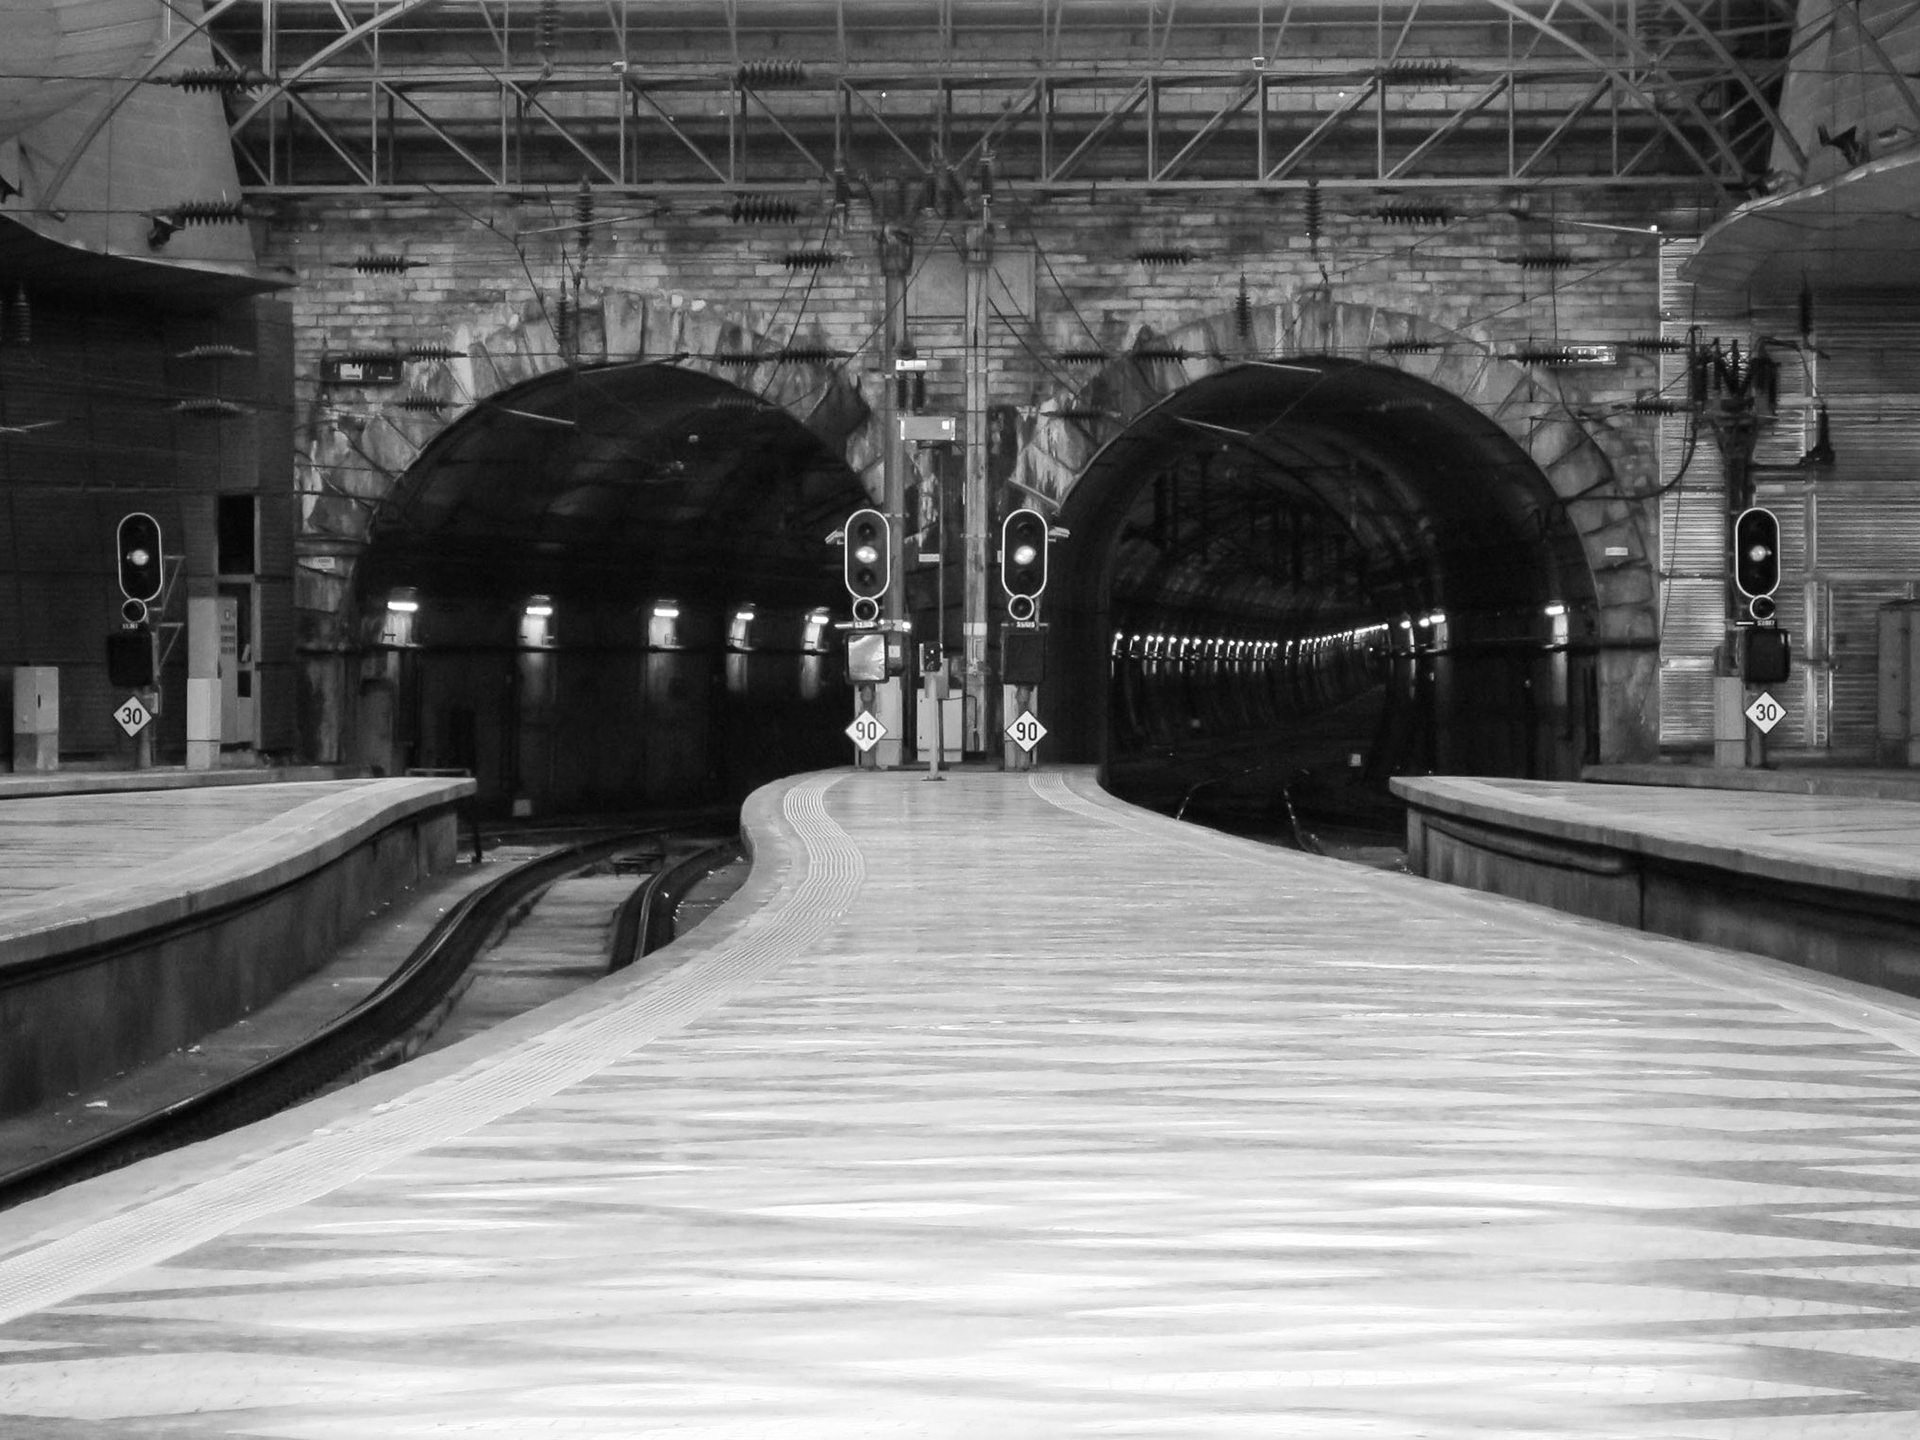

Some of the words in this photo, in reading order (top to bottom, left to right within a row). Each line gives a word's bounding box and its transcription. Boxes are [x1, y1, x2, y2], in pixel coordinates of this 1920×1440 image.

[122, 707, 142, 725] 30
[1756, 704, 1776, 722] 30
[856, 721, 876, 740] 90
[1016, 722, 1037, 741] 90
